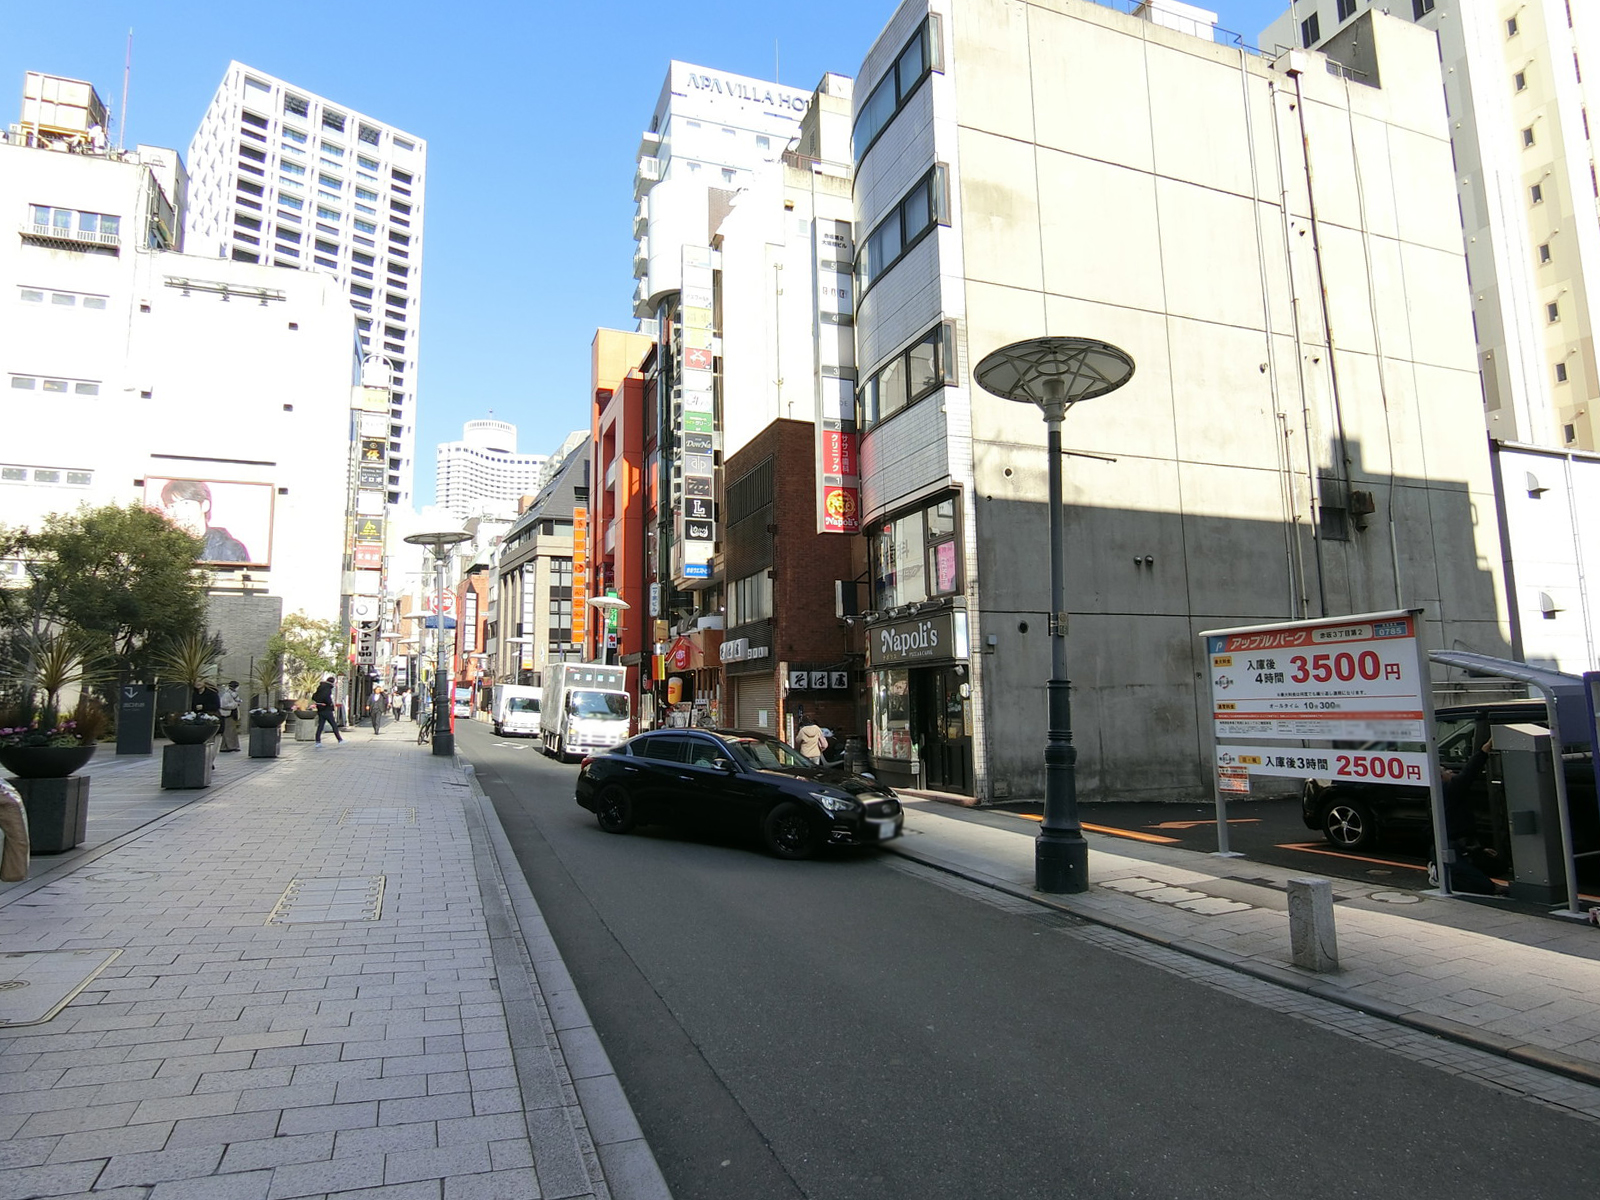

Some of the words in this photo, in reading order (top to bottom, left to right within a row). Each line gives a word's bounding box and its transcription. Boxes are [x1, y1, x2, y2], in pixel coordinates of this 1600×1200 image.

[687, 73, 722, 94] APA
[726, 81, 774, 105] VILLA
[831, 434, 840, 472] クリニック
[693, 499, 706, 514] L
[825, 516, 859, 528] Napoli's
[880, 621, 939, 657] Napoli's
[1230, 631, 1307, 650] アップルパーク
[1378, 627, 1403, 637] 0785
[1246, 658, 1276, 671] 入庫後
[1289, 650, 1402, 684] 3500円
[1254, 672, 1285, 685] 4時間
[1265, 756, 1329, 771] 入庫後3時間
[1335, 754, 1422, 780] 2500円
